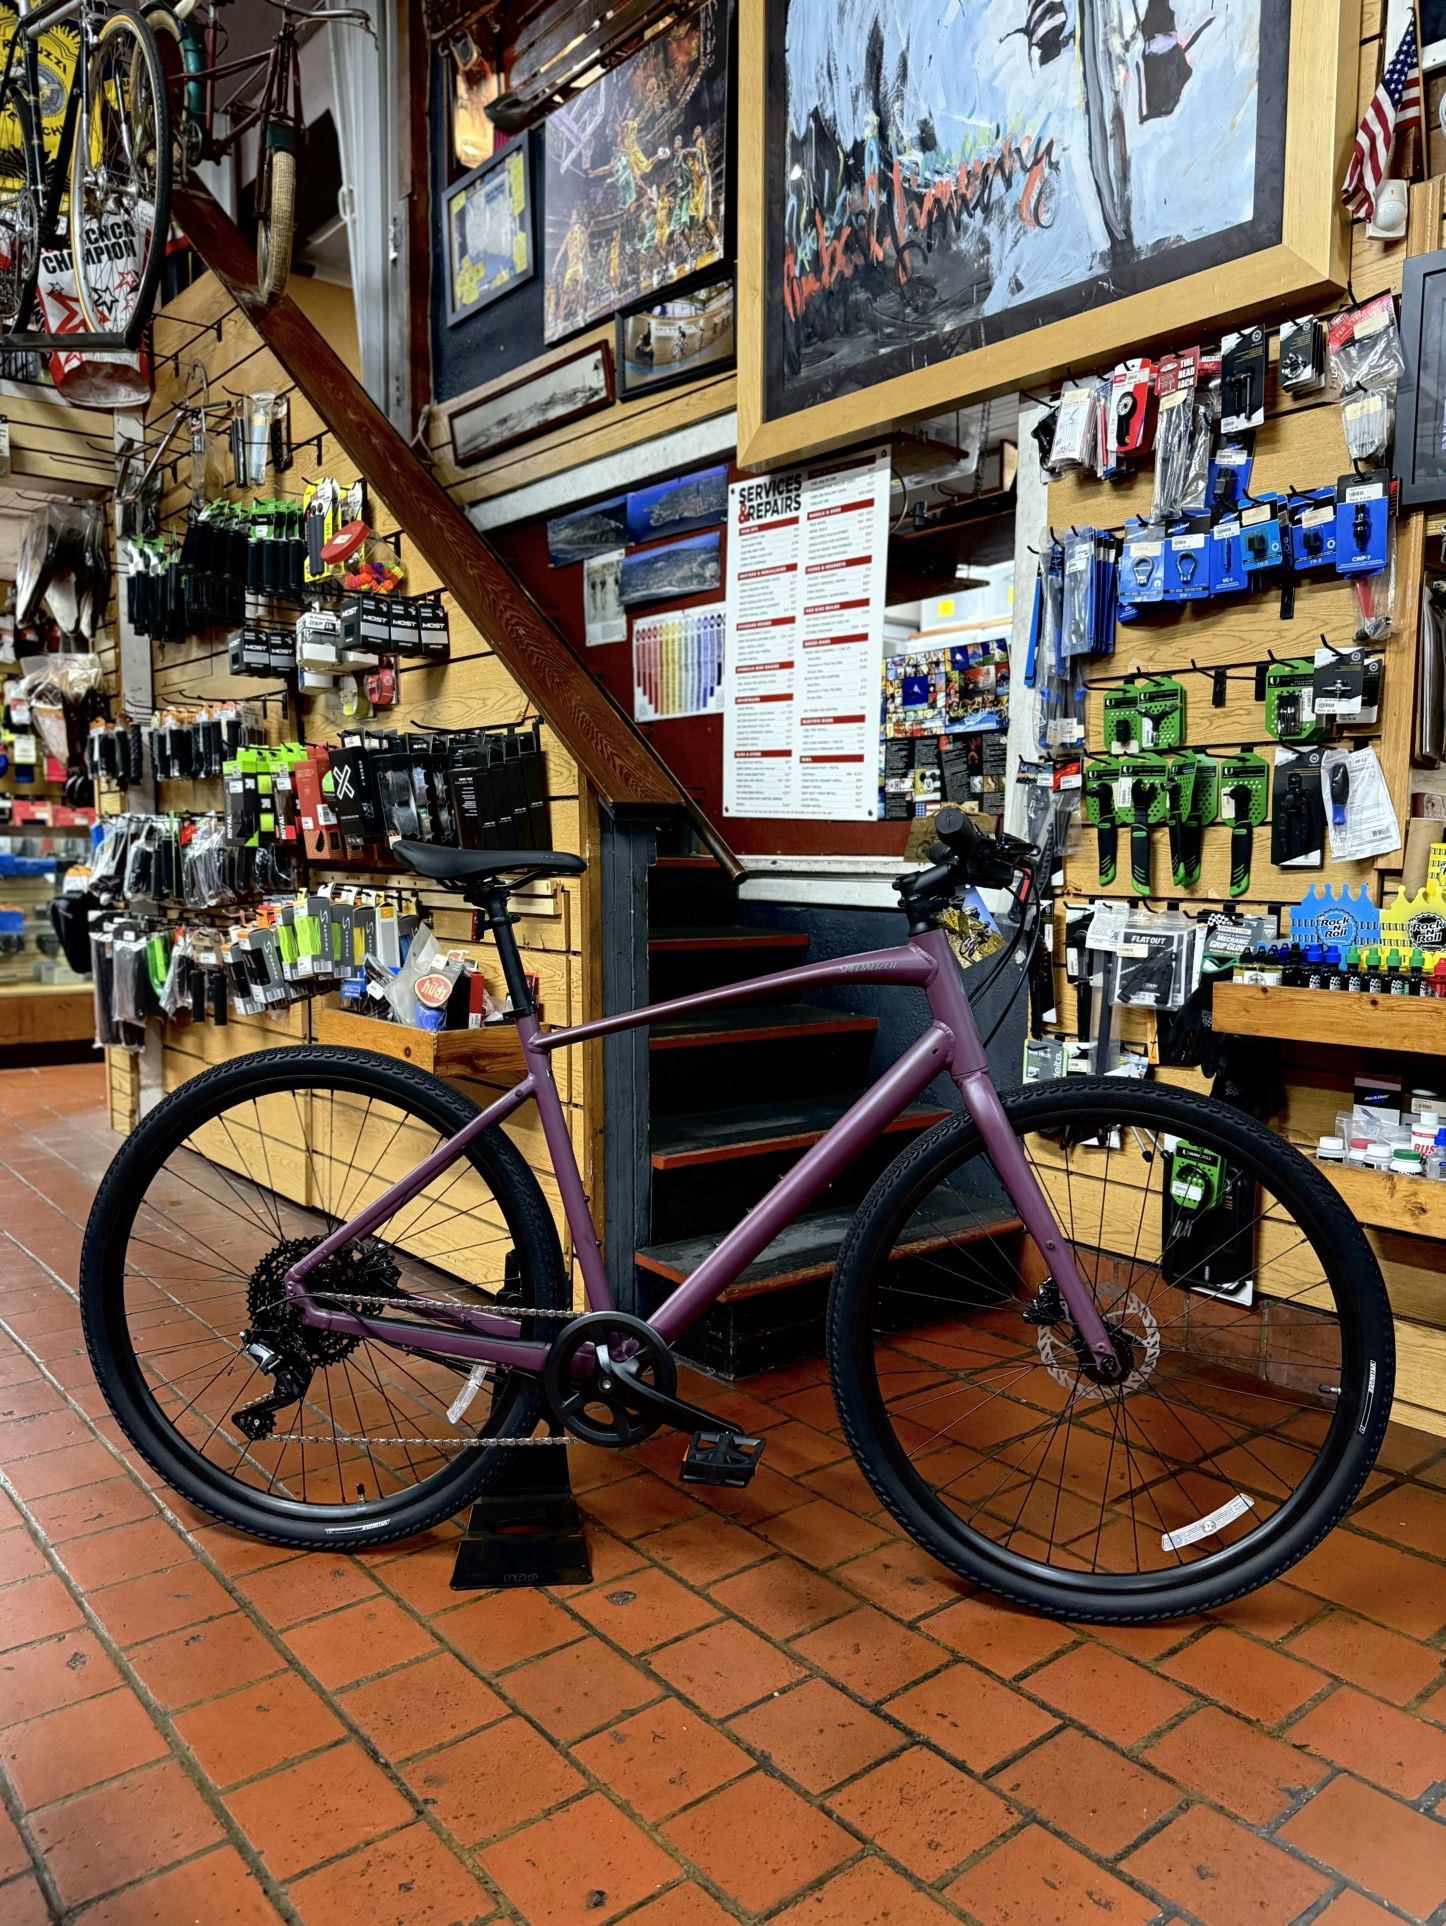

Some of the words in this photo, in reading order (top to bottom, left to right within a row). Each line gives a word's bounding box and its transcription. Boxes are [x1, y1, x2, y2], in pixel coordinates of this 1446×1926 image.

[1180, 356, 1194, 368] TIRE
[1178, 367, 1195, 379] BEAD
[1178, 378, 1195, 389] JACK
[739, 473, 802, 504] SERVICES
[738, 502, 749, 524] &
[748, 494, 802, 521] REPAIRS
[363, 614, 388, 623] MOST
[279, 815, 287, 840] ROYAL
[1320, 916, 1350, 927] Rock
[1413, 920, 1446, 932] Rock
[1216, 935, 1250, 944] MECHANIC
[1324, 930, 1348, 938] Roll
[1417, 933, 1442, 943] Roll
[1209, 940, 1227, 949] GRIP
[840, 961, 898, 973] SPECIALIZED
